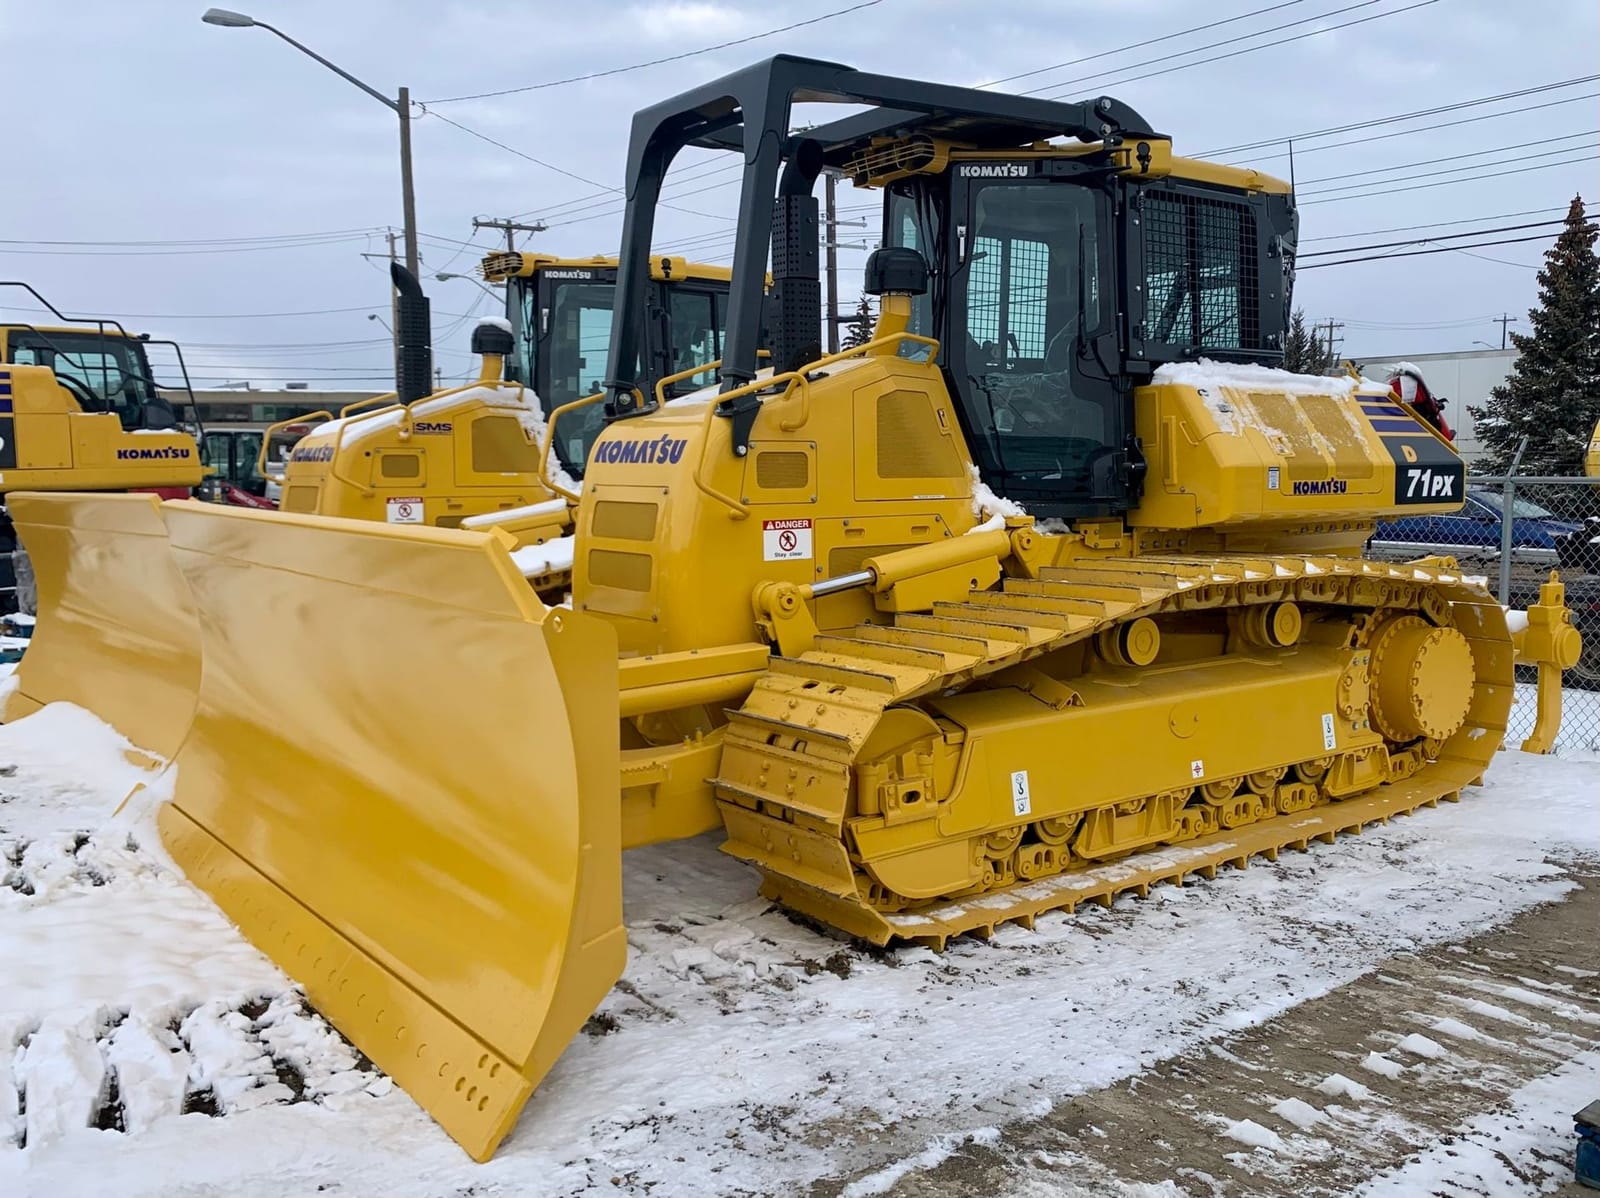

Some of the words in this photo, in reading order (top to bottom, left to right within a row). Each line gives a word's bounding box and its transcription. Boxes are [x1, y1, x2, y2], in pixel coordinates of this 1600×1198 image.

[960, 163, 1028, 177] KOMATSU
[544, 269, 592, 279] KOMATSU
[415, 422, 453, 431] SMS
[117, 446, 190, 459] KOMATSU
[593, 433, 688, 464] KOMATSU
[1401, 445, 1418, 463] D
[1293, 477, 1347, 495] KOMATSU
[1407, 469, 1456, 498] 71PX
[775, 520, 809, 529] DANGER
